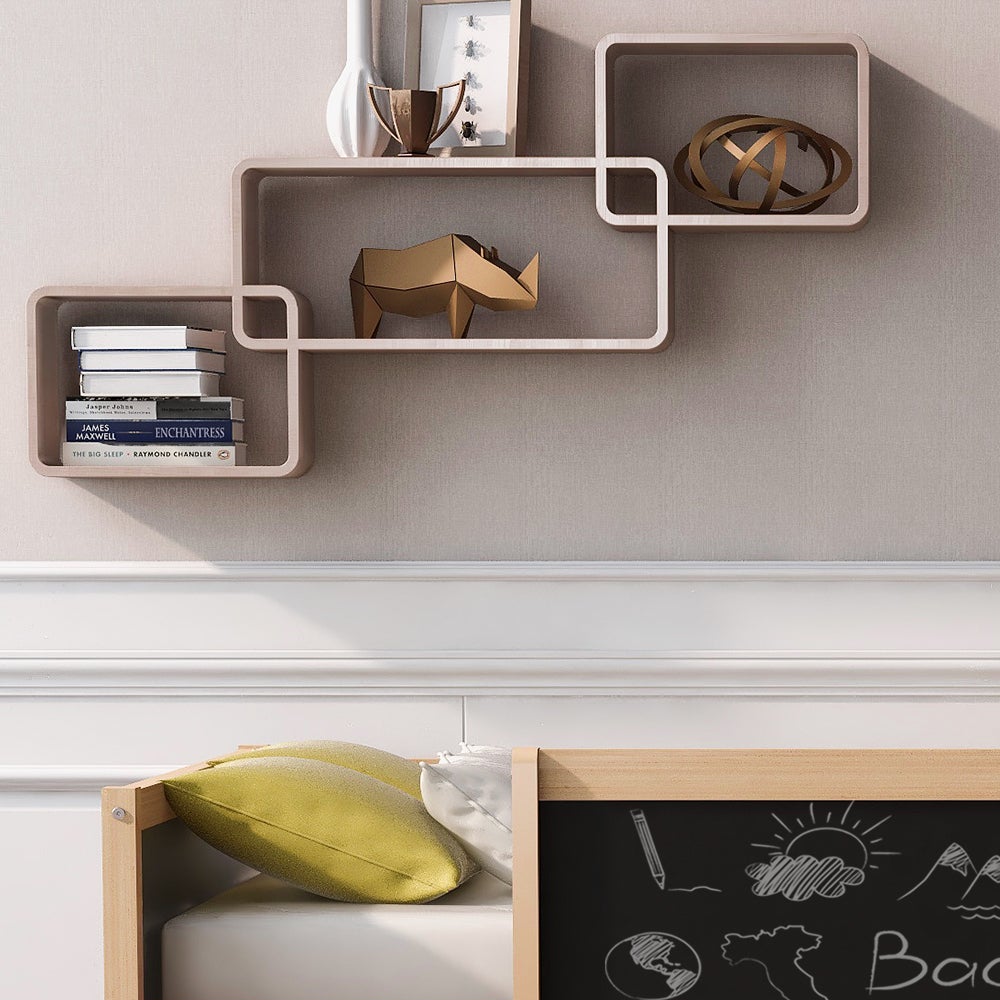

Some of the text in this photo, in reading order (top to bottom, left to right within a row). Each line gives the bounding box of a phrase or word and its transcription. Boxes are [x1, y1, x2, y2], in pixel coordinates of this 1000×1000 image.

[82, 424, 110, 432] JAMES
[75, 432, 116, 440] MAXWELL
[155, 427, 225, 438] ENCHANTRESS
